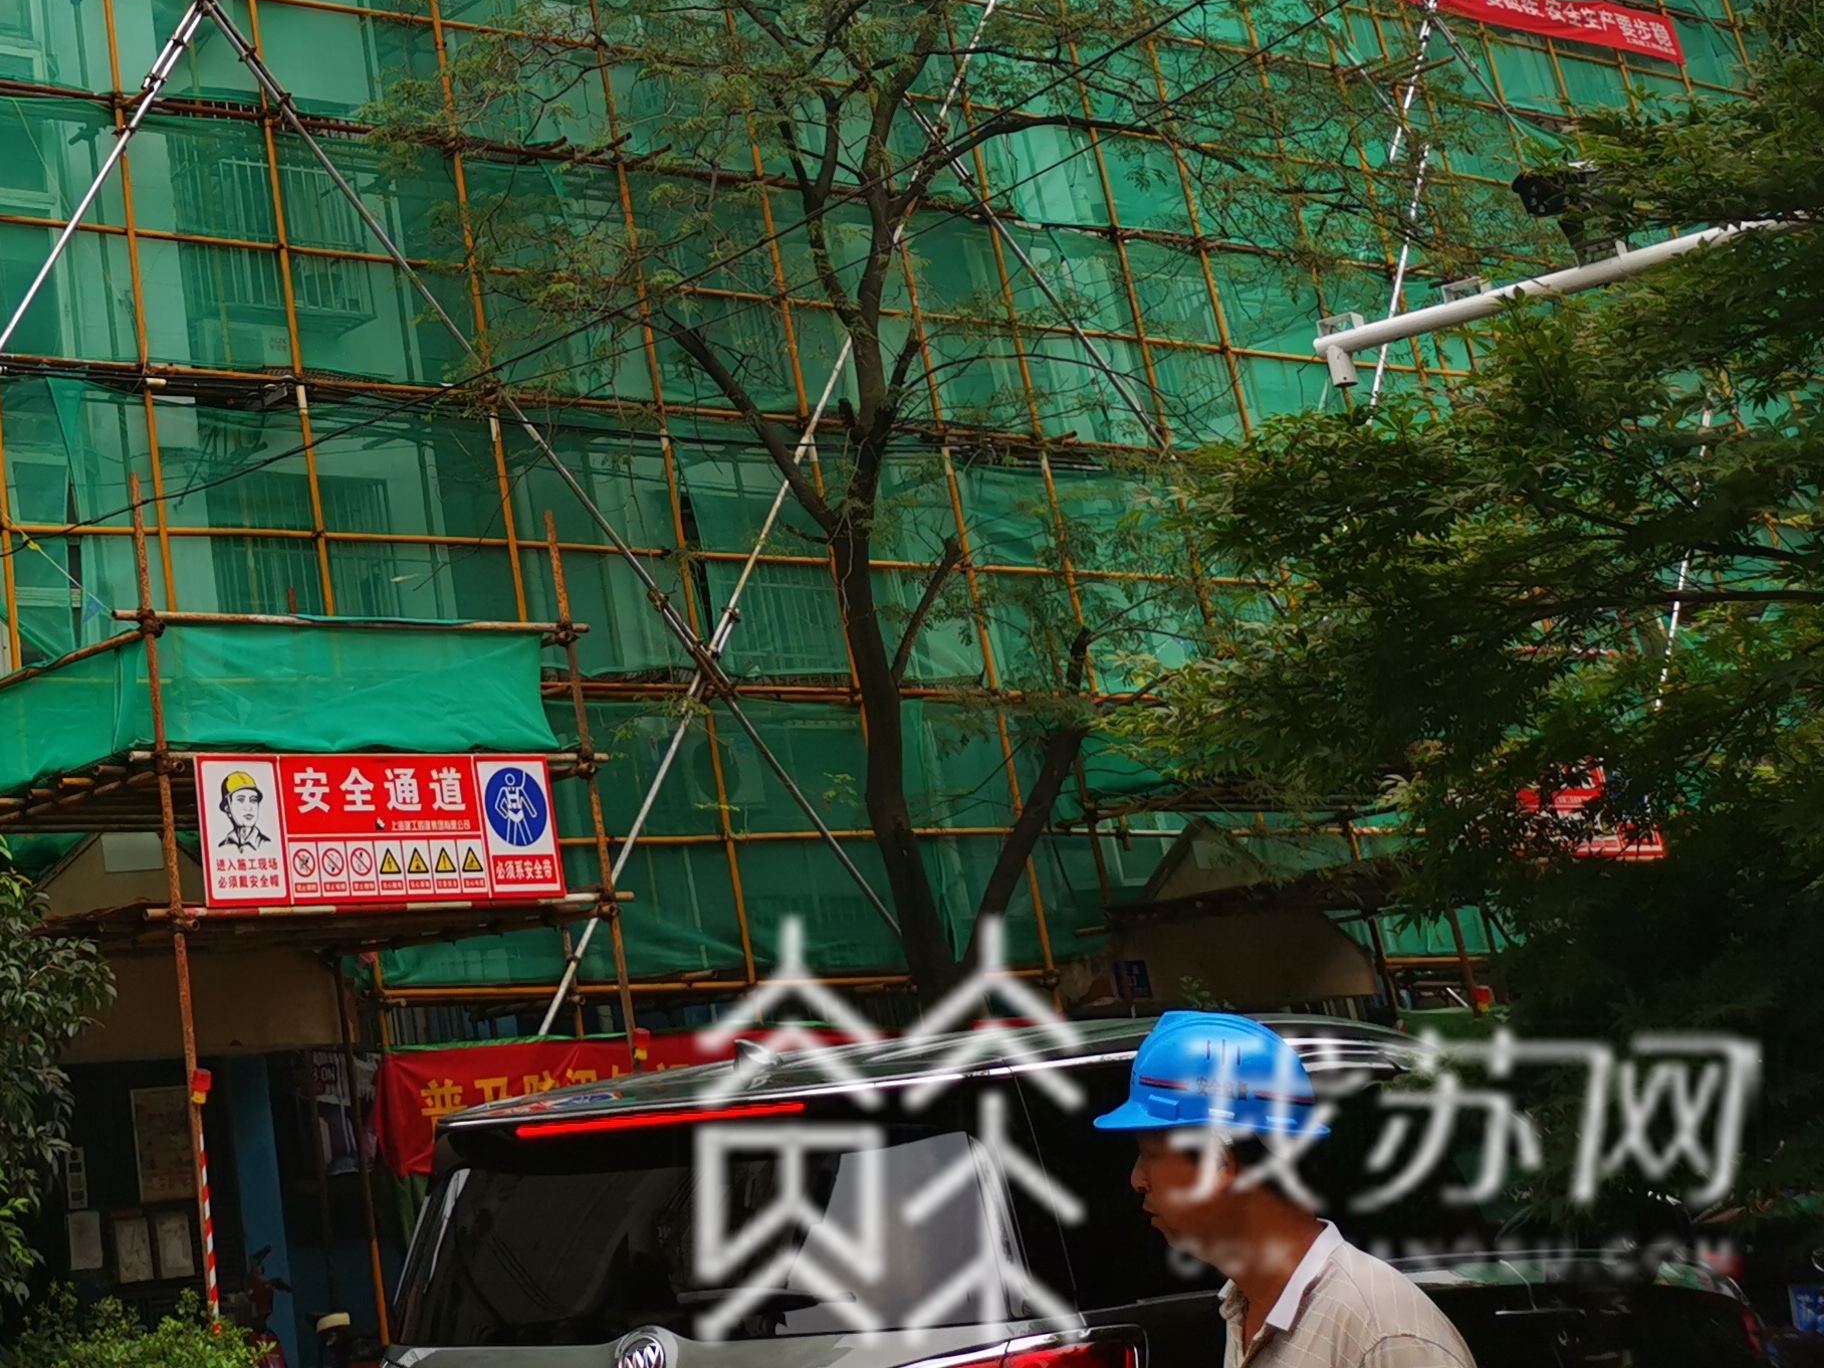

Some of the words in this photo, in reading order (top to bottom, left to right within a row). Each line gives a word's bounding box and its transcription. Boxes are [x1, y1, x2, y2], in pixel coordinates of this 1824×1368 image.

[293, 766, 466, 813] 安全通道
[216, 857, 279, 872] 进入施工现场
[495, 858, 552, 880] 必须系安全带
[217, 874, 280, 889] 必须戴安全帽
